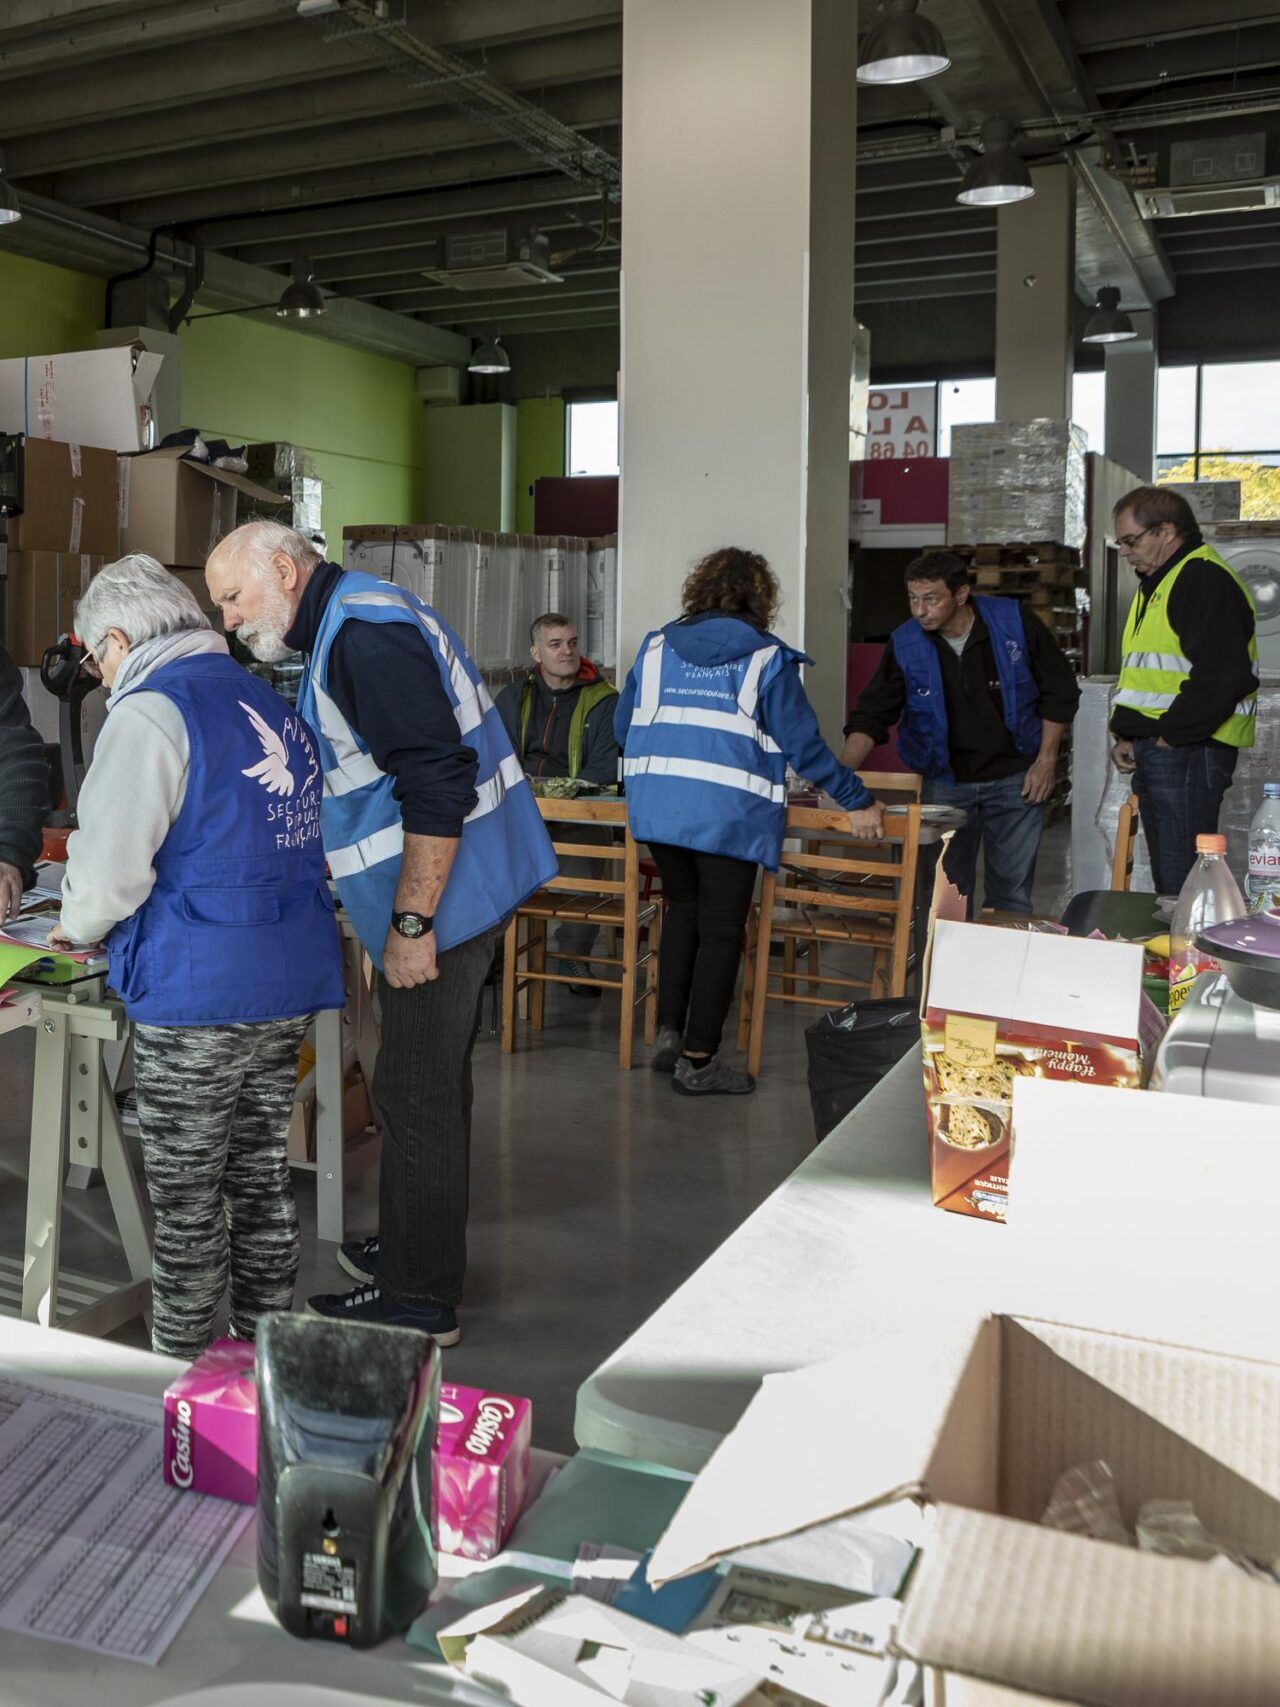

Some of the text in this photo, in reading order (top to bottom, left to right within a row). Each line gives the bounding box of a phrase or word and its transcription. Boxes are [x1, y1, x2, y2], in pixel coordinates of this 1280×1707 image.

[1046, 1057, 1097, 1078] Happy
[170, 1400, 193, 1489] Casino
[464, 1396, 515, 1456] Casino
